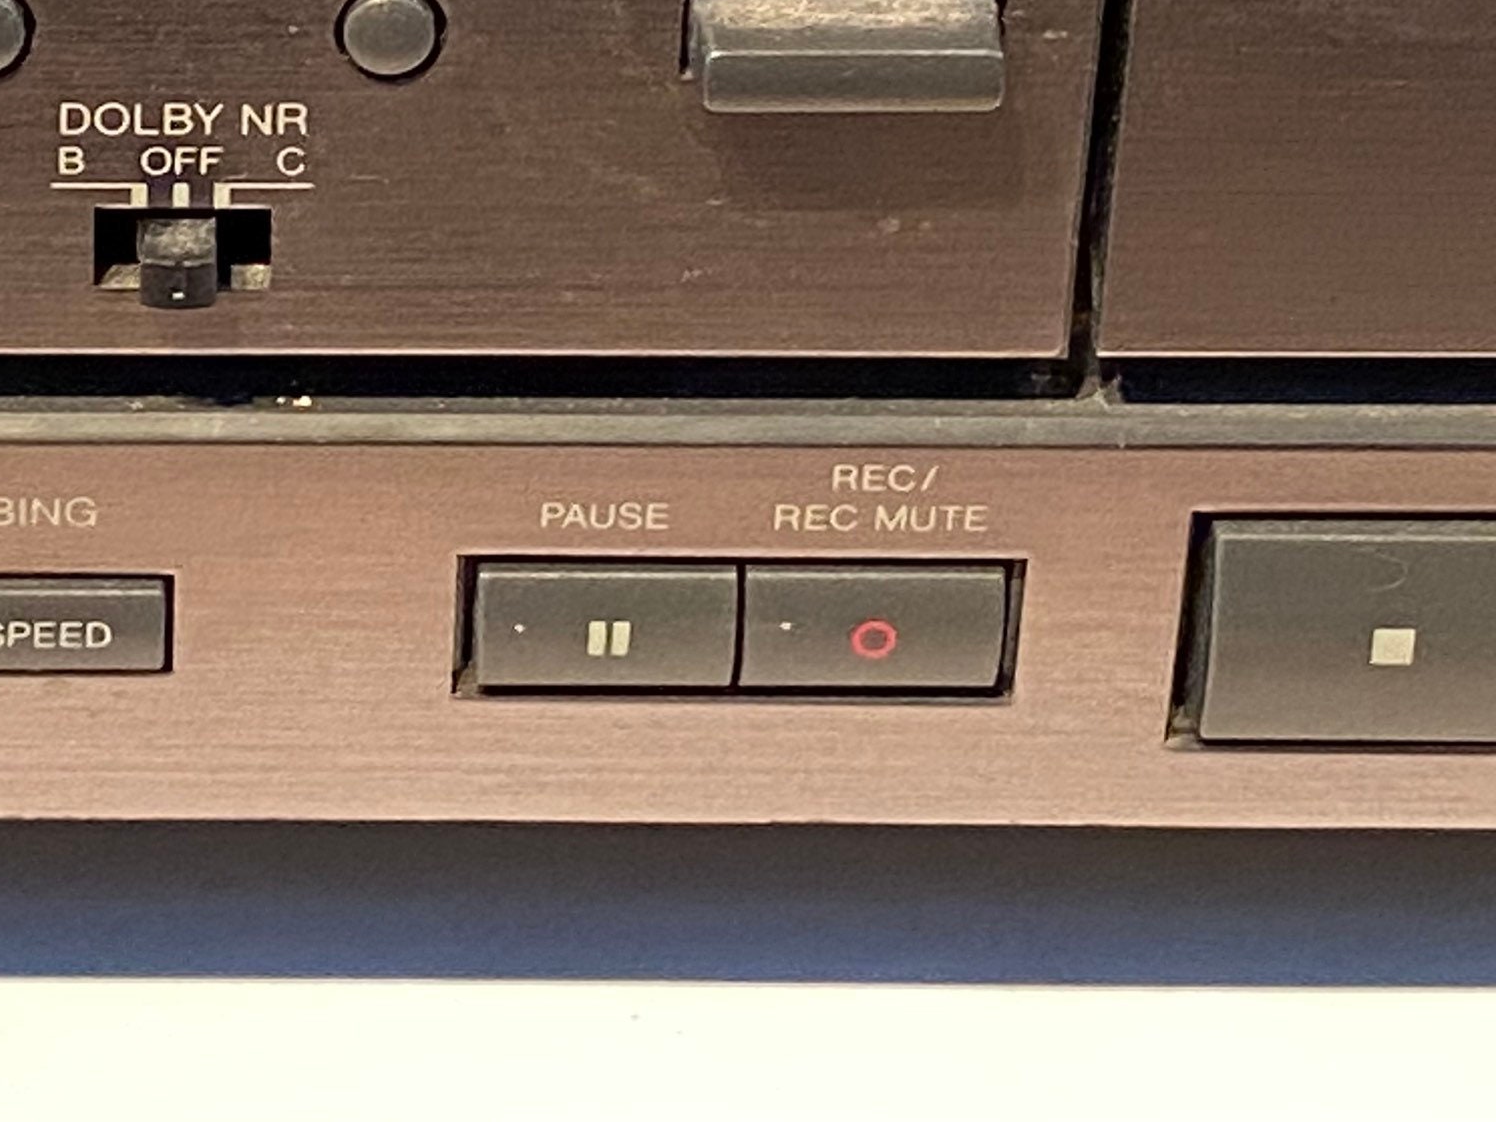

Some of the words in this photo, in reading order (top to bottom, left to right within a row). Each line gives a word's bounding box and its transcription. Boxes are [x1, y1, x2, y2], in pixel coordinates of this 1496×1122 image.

[59, 102, 224, 136] DOLBY
[241, 102, 308, 136] NR
[58, 146, 85, 175] B
[140, 146, 224, 176] OFF
[276, 146, 305, 176] C
[832, 464, 939, 492] REC/
[540, 502, 669, 530] PAUSE
[774, 504, 858, 532] REC
[875, 505, 988, 532] MUTE
